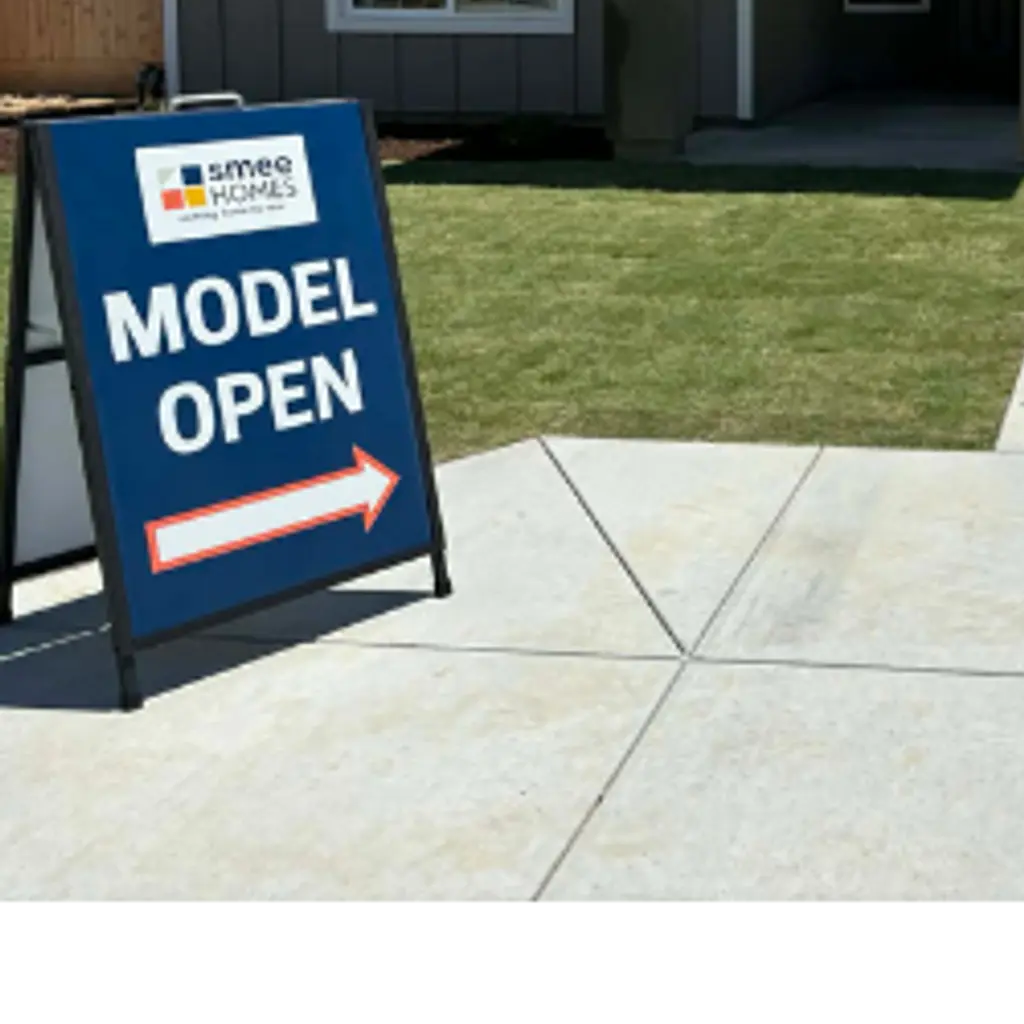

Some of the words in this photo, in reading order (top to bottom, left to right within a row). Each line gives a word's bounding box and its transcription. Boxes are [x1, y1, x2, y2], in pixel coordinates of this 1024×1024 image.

[208, 155, 293, 181] smee
[210, 178, 298, 205] HOMES
[103, 258, 377, 362] MODEL
[158, 349, 364, 454] OPEN
